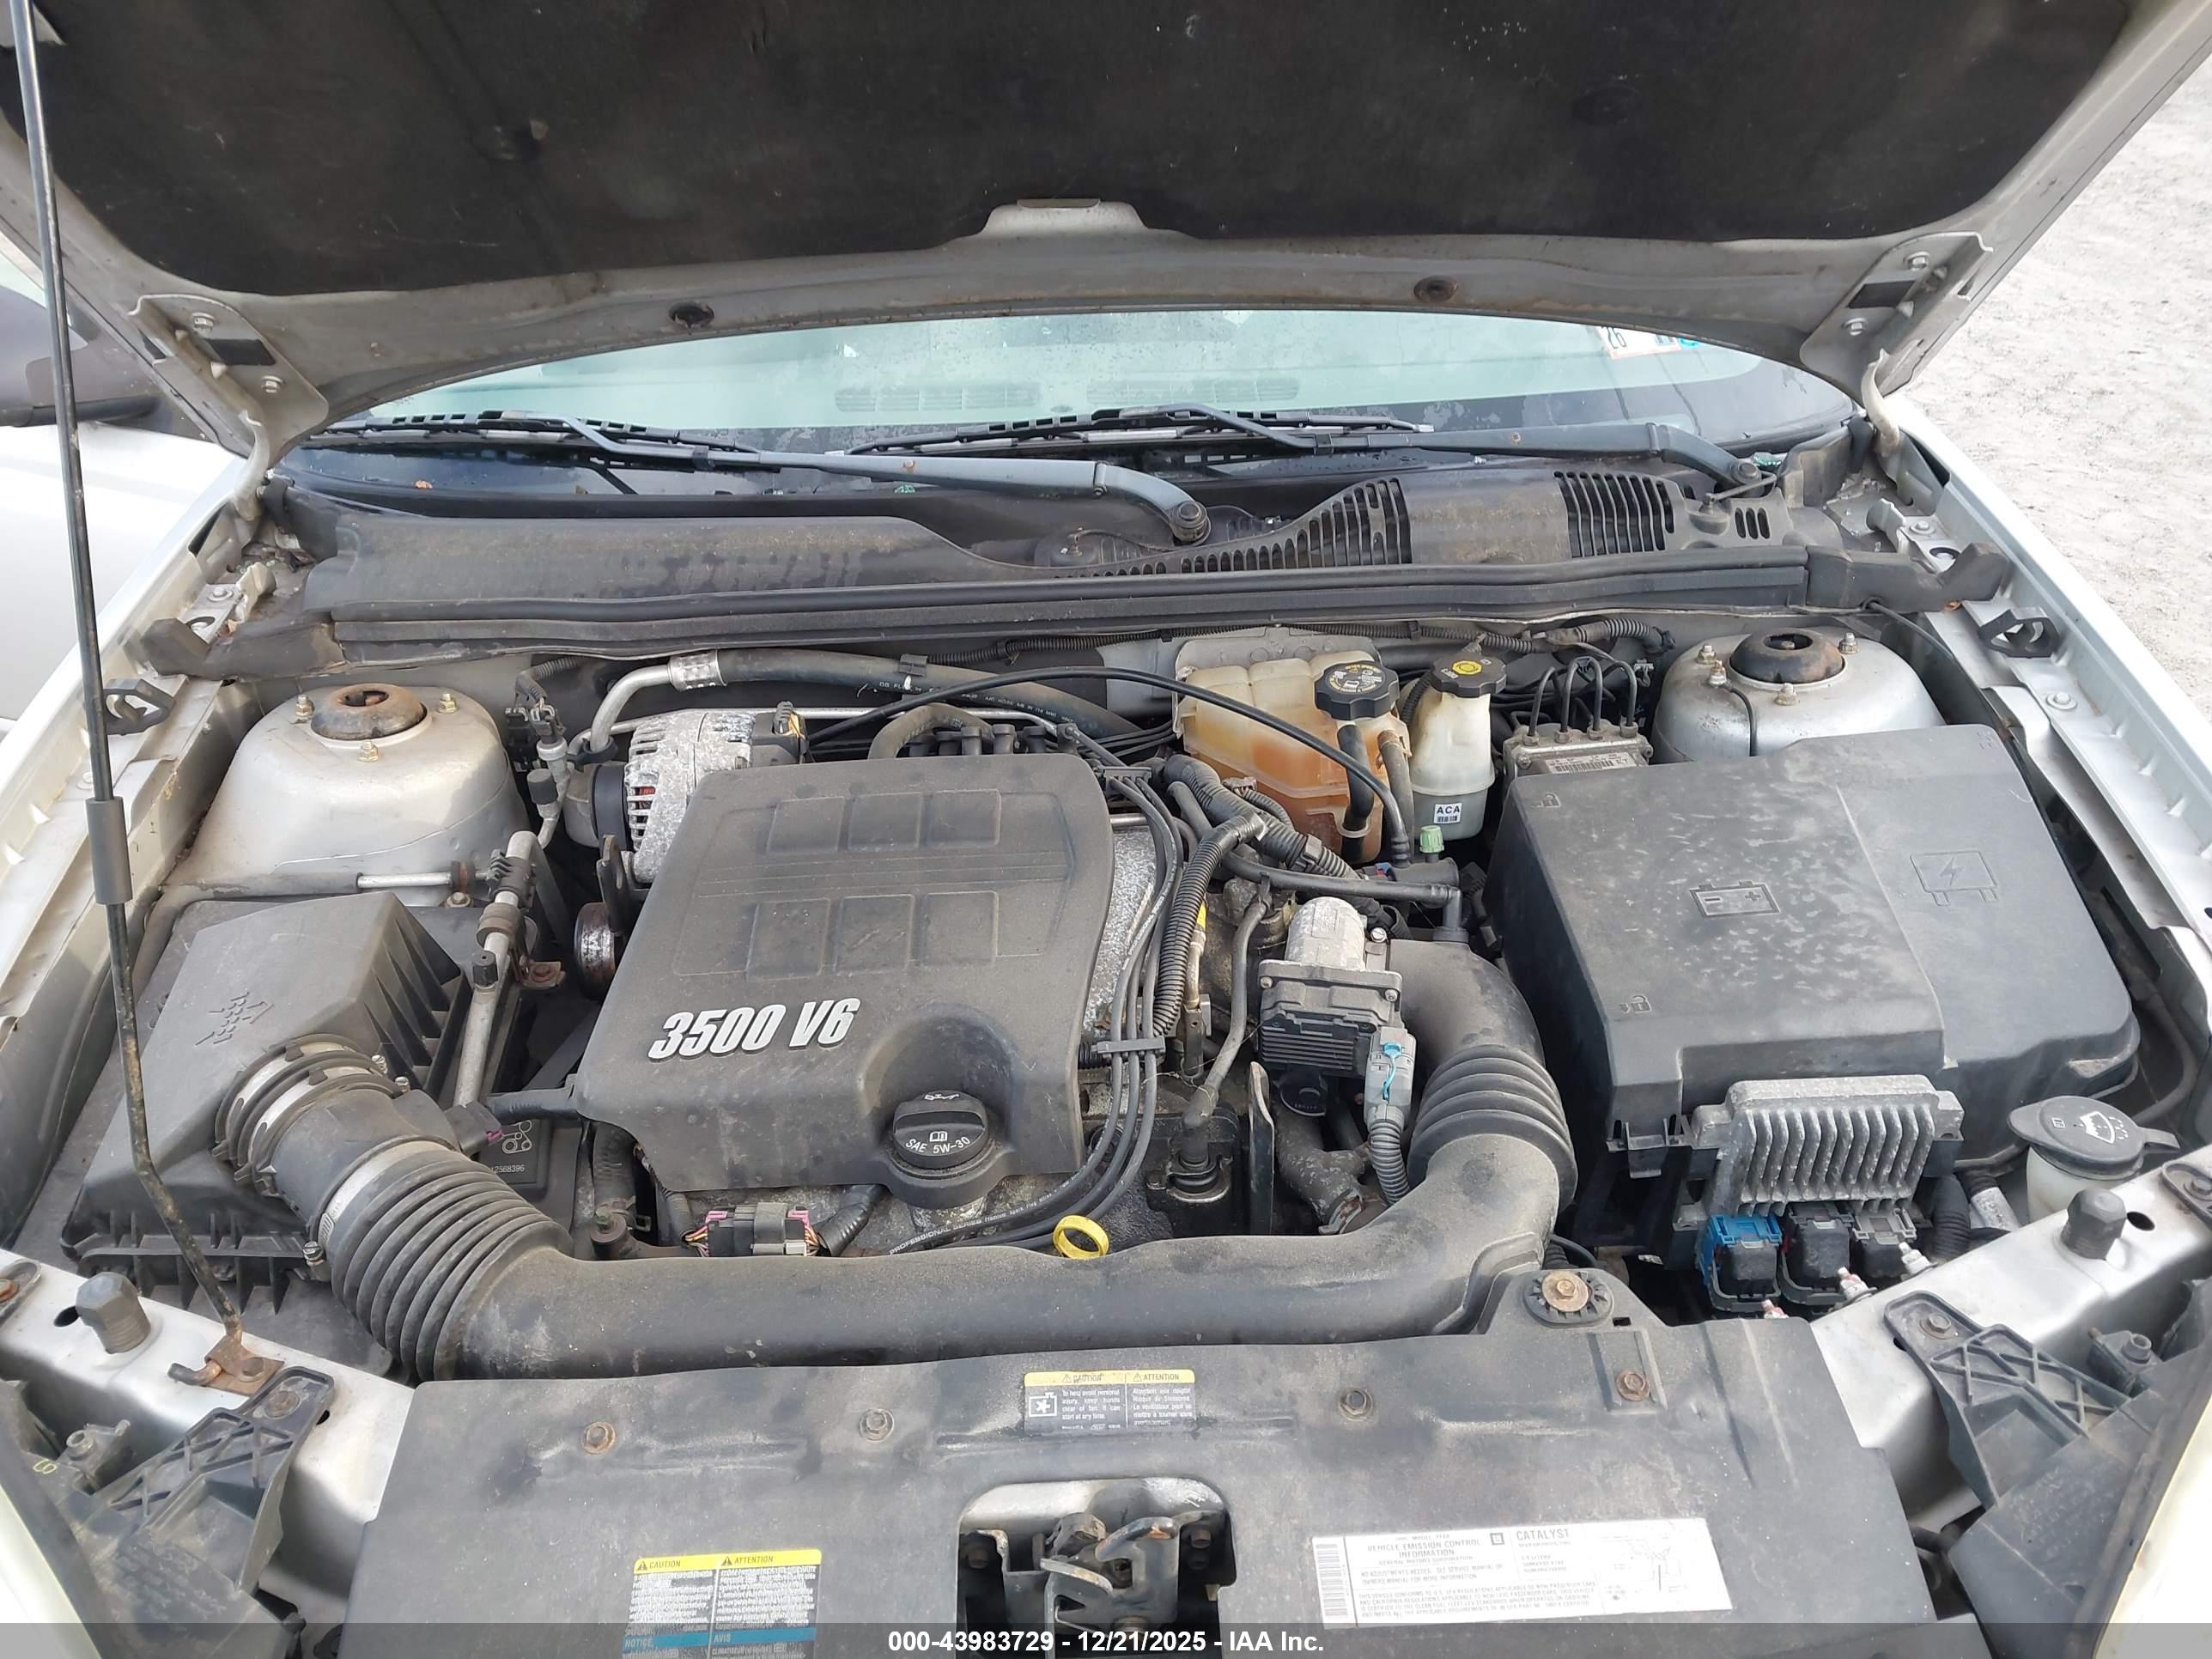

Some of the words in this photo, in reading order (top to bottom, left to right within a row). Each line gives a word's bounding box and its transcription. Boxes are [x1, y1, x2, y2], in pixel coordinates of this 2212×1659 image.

[1436, 805, 1461, 814] ACA
[647, 1005, 787, 1061] 3500
[789, 997, 861, 1050] V6
[906, 1139, 927, 1153] SAE
[933, 1136, 970, 1153] 5W-30
[889, 1227, 951, 1255] PROFESSIONAL
[1516, 1528, 1569, 1541] CATALYST
[1403, 1541, 1442, 1551] EMISSION
[1444, 1539, 1480, 1547] CONTROL
[1399, 1549, 1455, 1559] INFORMATION
[649, 1560, 681, 1569] CAUTION
[734, 1556, 774, 1565] ATTENTION
[714, 1633, 731, 1643] AVIS
